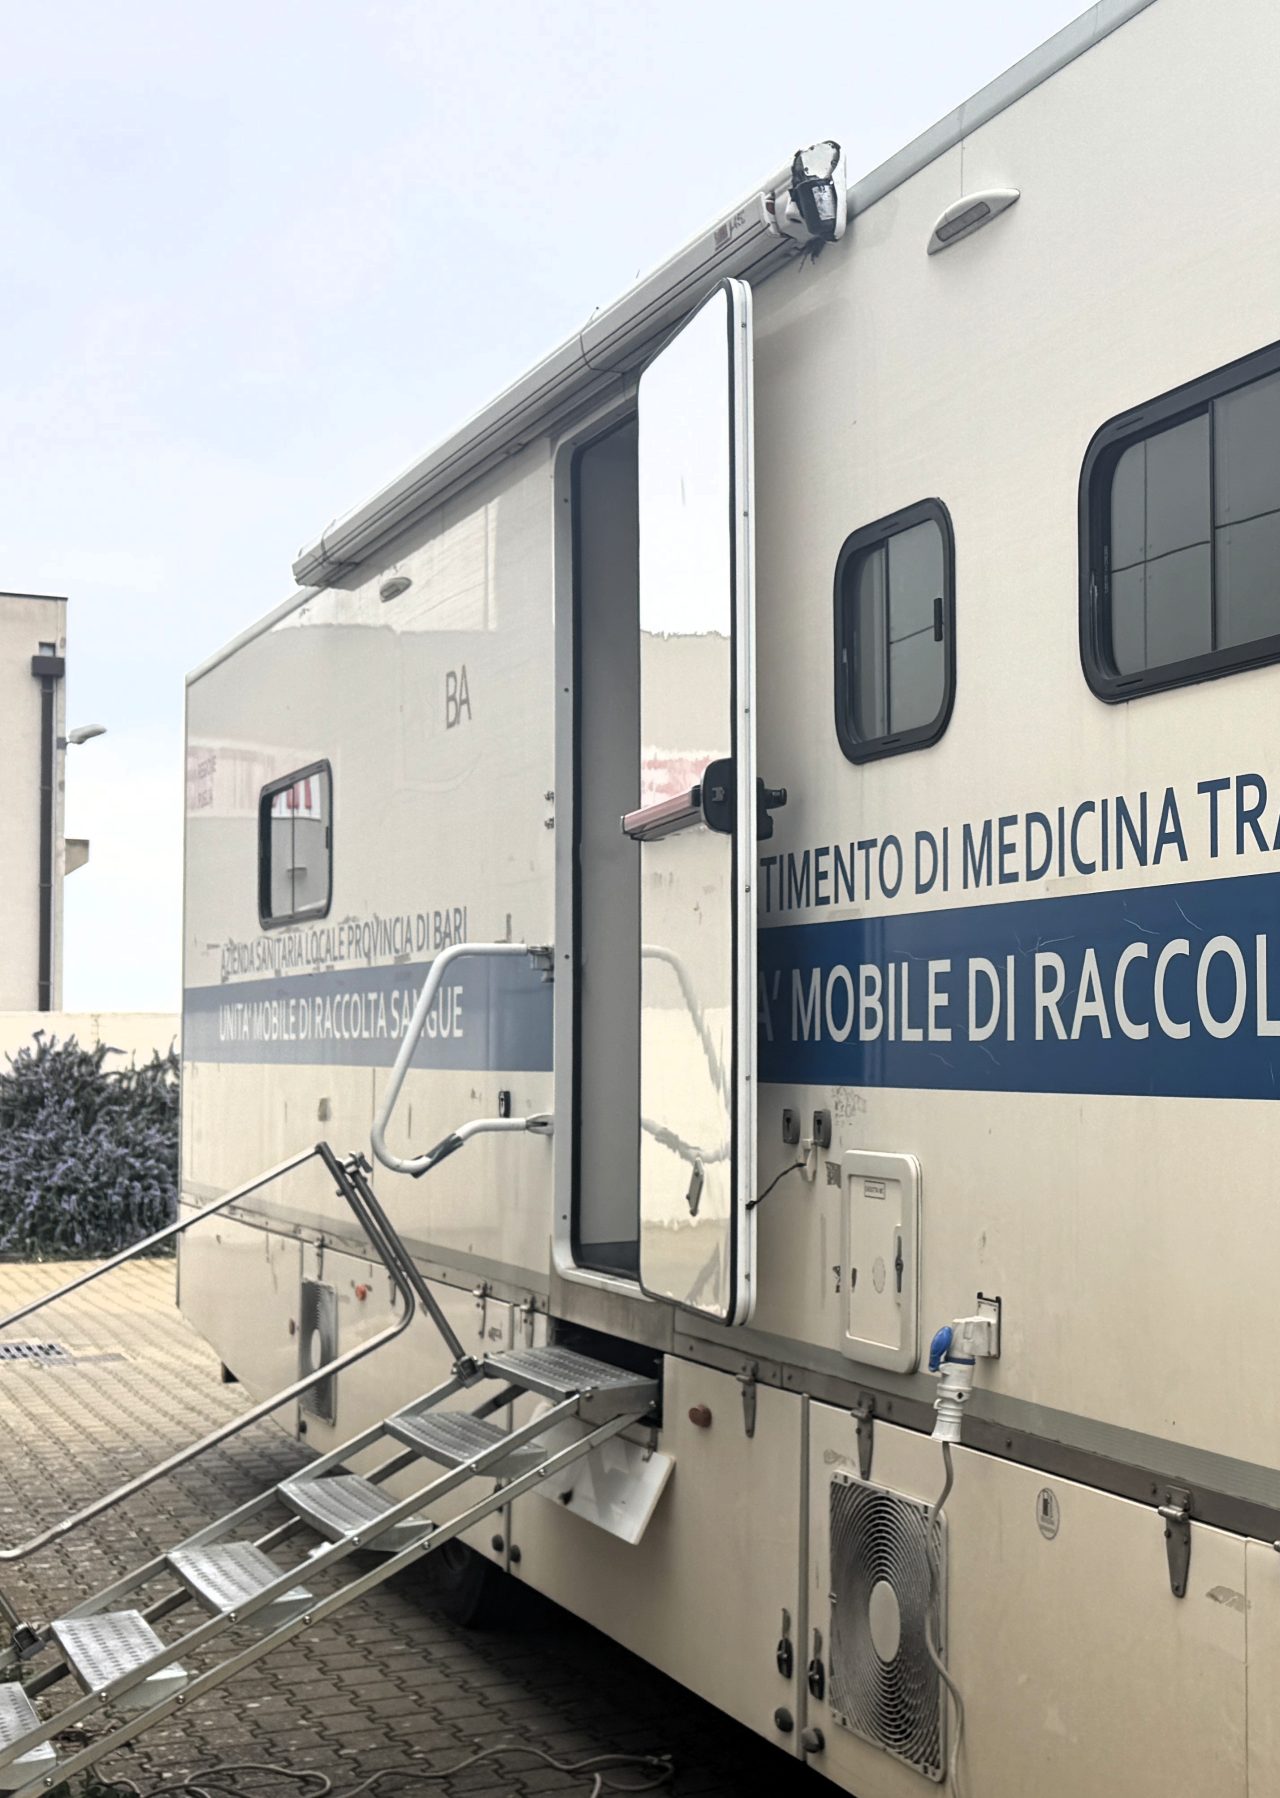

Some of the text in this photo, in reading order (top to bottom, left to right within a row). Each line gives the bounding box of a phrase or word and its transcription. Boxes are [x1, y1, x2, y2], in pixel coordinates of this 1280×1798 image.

[445, 664, 472, 729] BA
[760, 835, 904, 913] TIMENTO
[914, 826, 950, 894] DI
[962, 786, 1188, 890] MEDICINA
[256, 931, 305, 972] SANITARIA
[305, 926, 345, 965] LOCALE
[347, 915, 413, 961] PROVINCIA
[416, 912, 431, 952] DI
[434, 906, 468, 951] BARI
[253, 999, 297, 1041] MOBILE
[299, 996, 312, 1040] DI
[315, 991, 388, 1040] RACCOLTA
[792, 958, 952, 1043] MOBILE
[967, 954, 1015, 1042] DI
